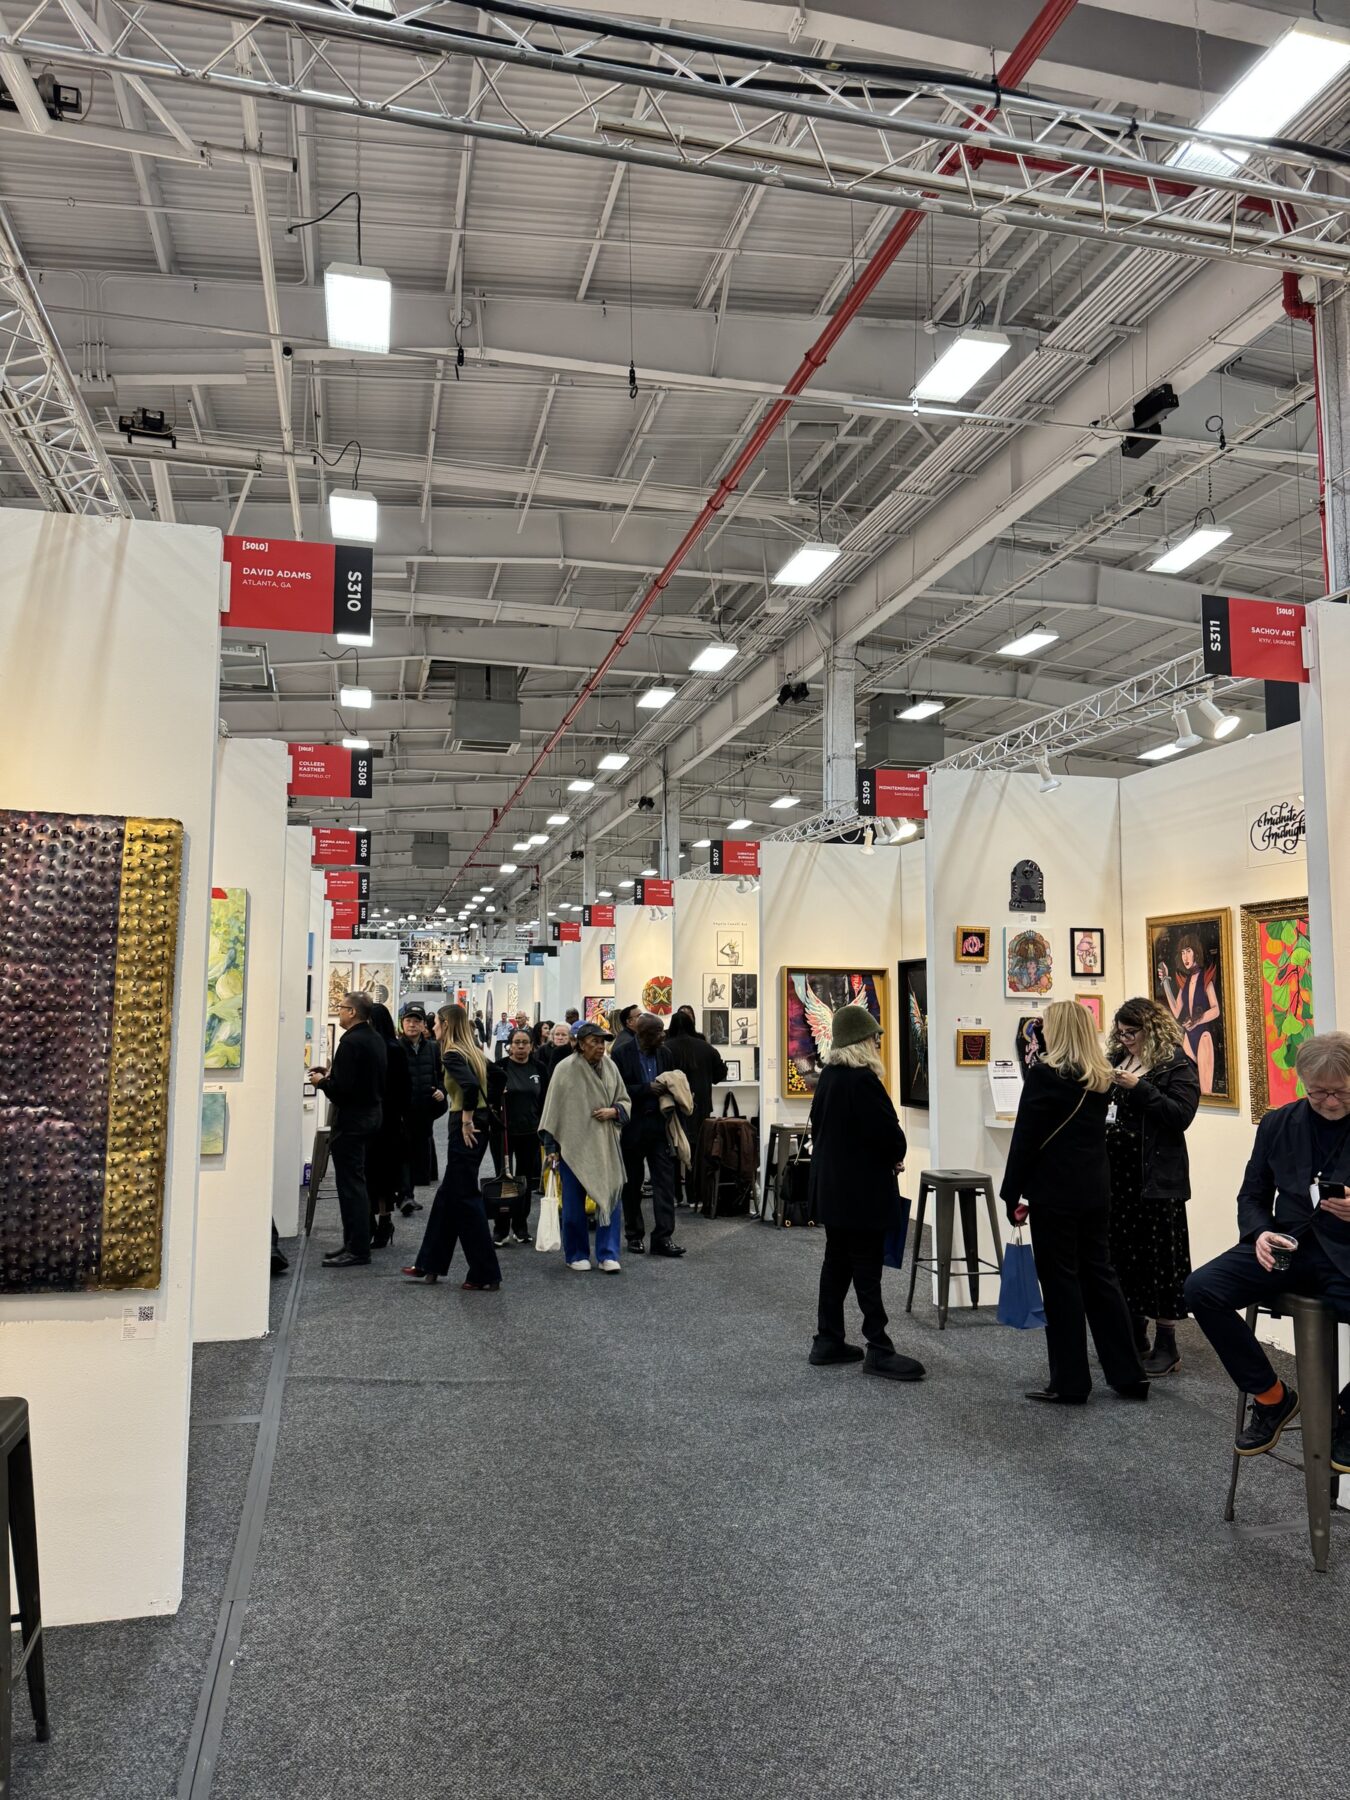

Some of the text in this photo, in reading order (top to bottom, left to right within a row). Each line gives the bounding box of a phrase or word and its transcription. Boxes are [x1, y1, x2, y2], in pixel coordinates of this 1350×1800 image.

[242, 540, 269, 553] [SOLO]
[242, 567, 312, 580] DAVID ADAMS
[242, 580, 279, 588] ATLANTA,
[347, 570, 362, 612] S310
[1209, 620, 1221, 652] S311
[1250, 626, 1295, 637] SACHOV ART
[358, 760, 367, 786] S308
[862, 780, 870, 805] S309
